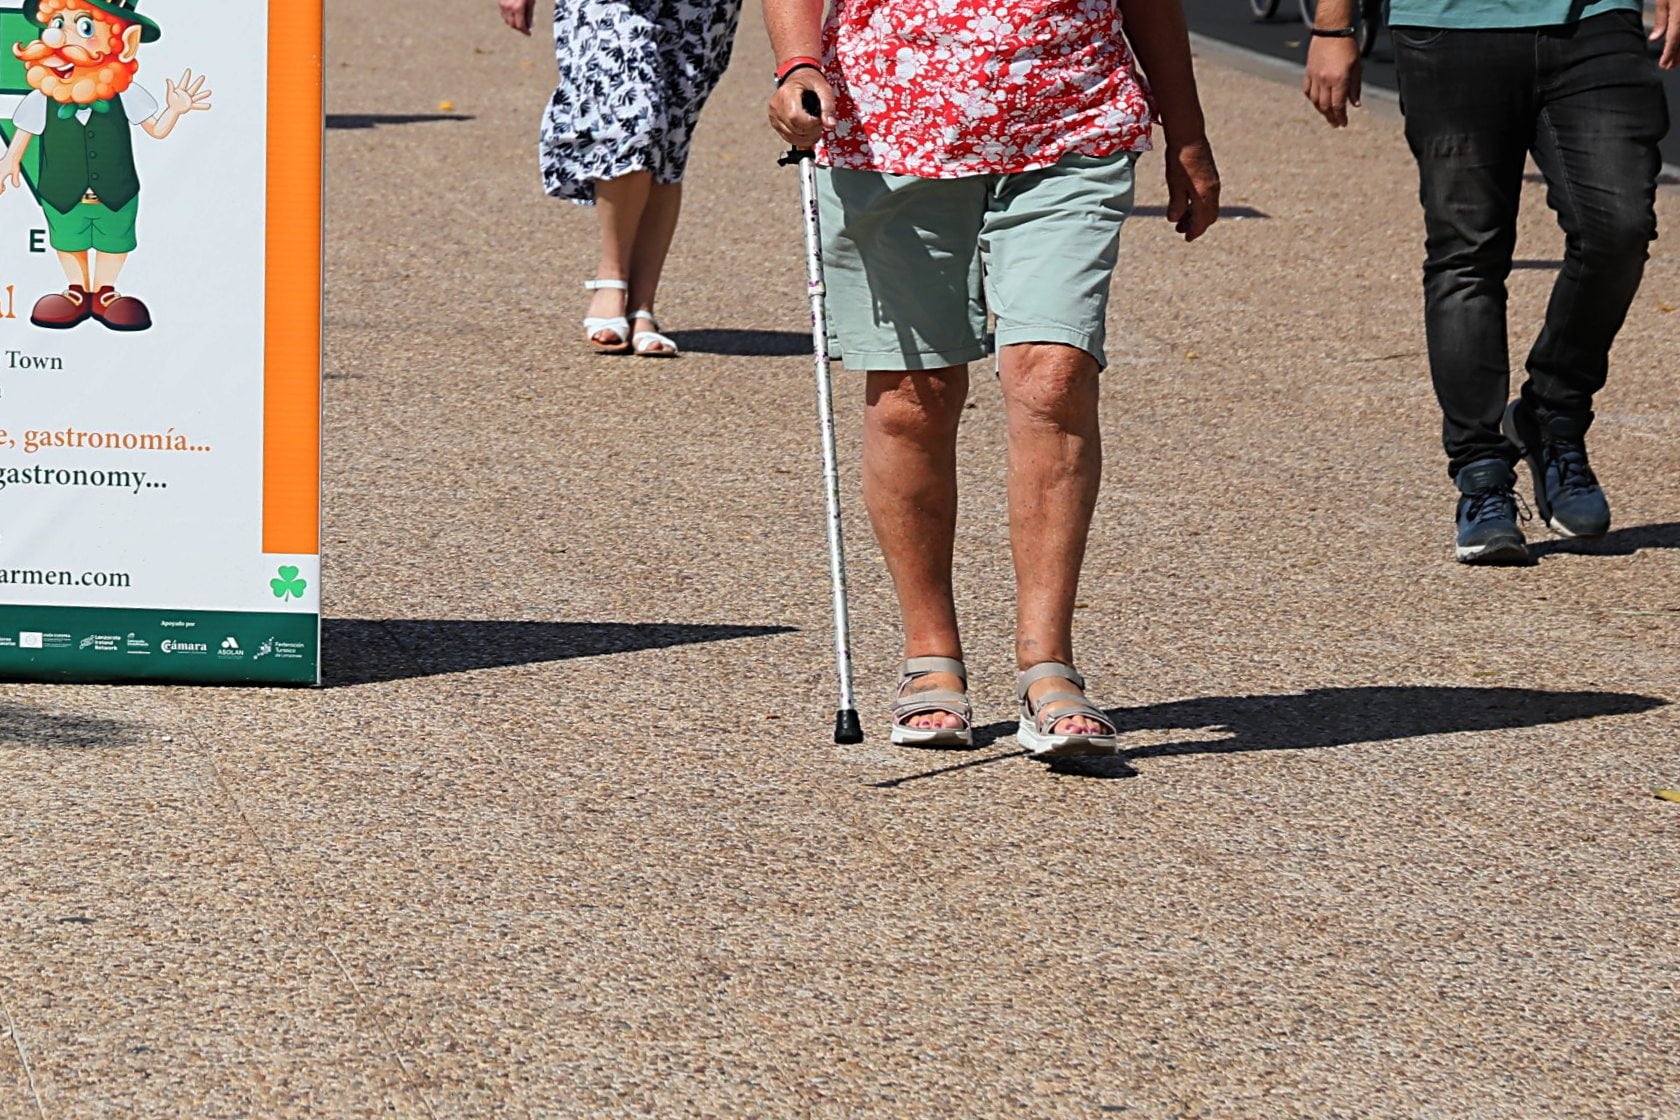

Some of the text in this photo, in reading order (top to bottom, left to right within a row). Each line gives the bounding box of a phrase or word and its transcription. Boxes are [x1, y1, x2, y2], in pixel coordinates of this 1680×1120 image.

[4, 350, 64, 371] Town
[23, 426, 212, 454] gastronomía...
[160, 639, 208, 653] Cámara
[217, 649, 245, 657] ASOLAN
